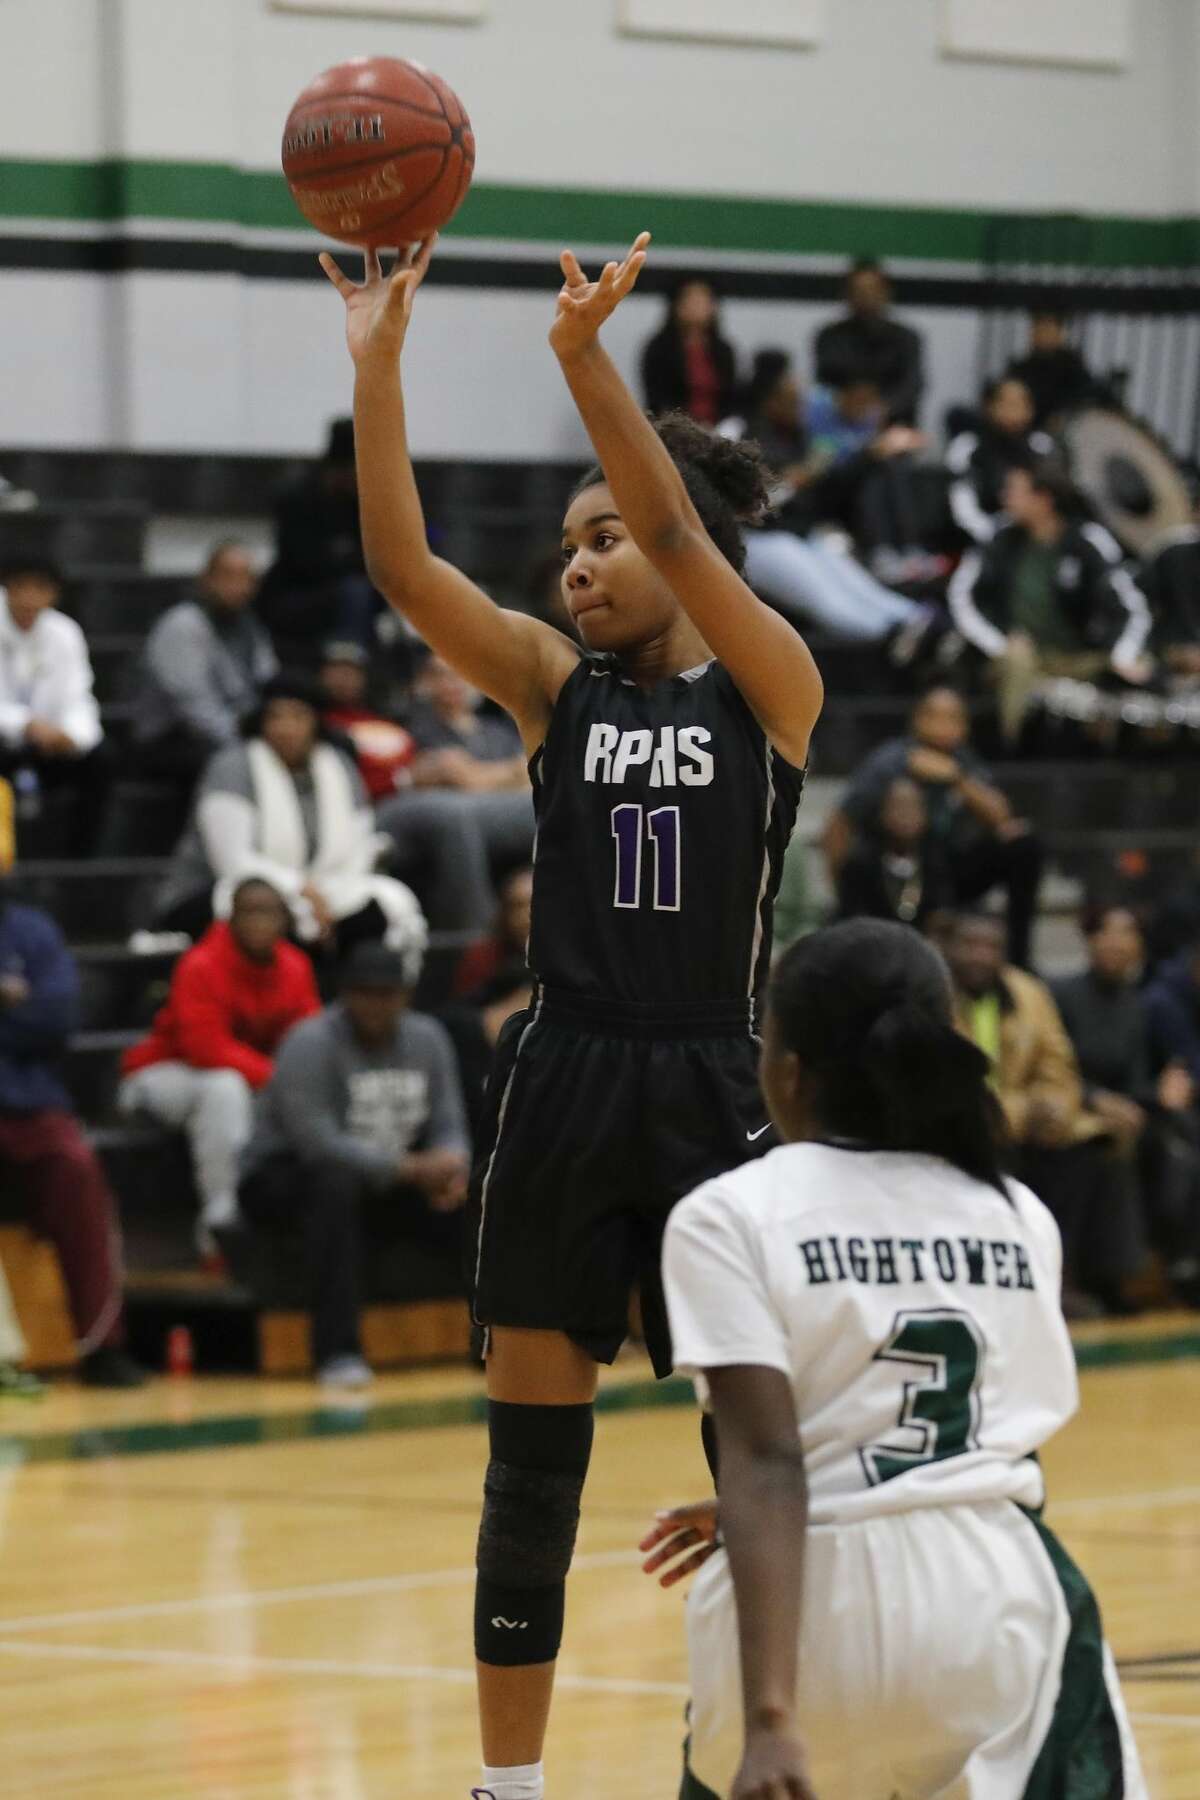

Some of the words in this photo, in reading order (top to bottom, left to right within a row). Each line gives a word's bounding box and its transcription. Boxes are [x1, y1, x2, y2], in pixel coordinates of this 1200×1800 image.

[584, 723, 714, 788] RPHS
[611, 803, 681, 911] 11
[798, 1237, 1035, 1291] HIGHTOWER
[857, 1307, 987, 1487] 3
